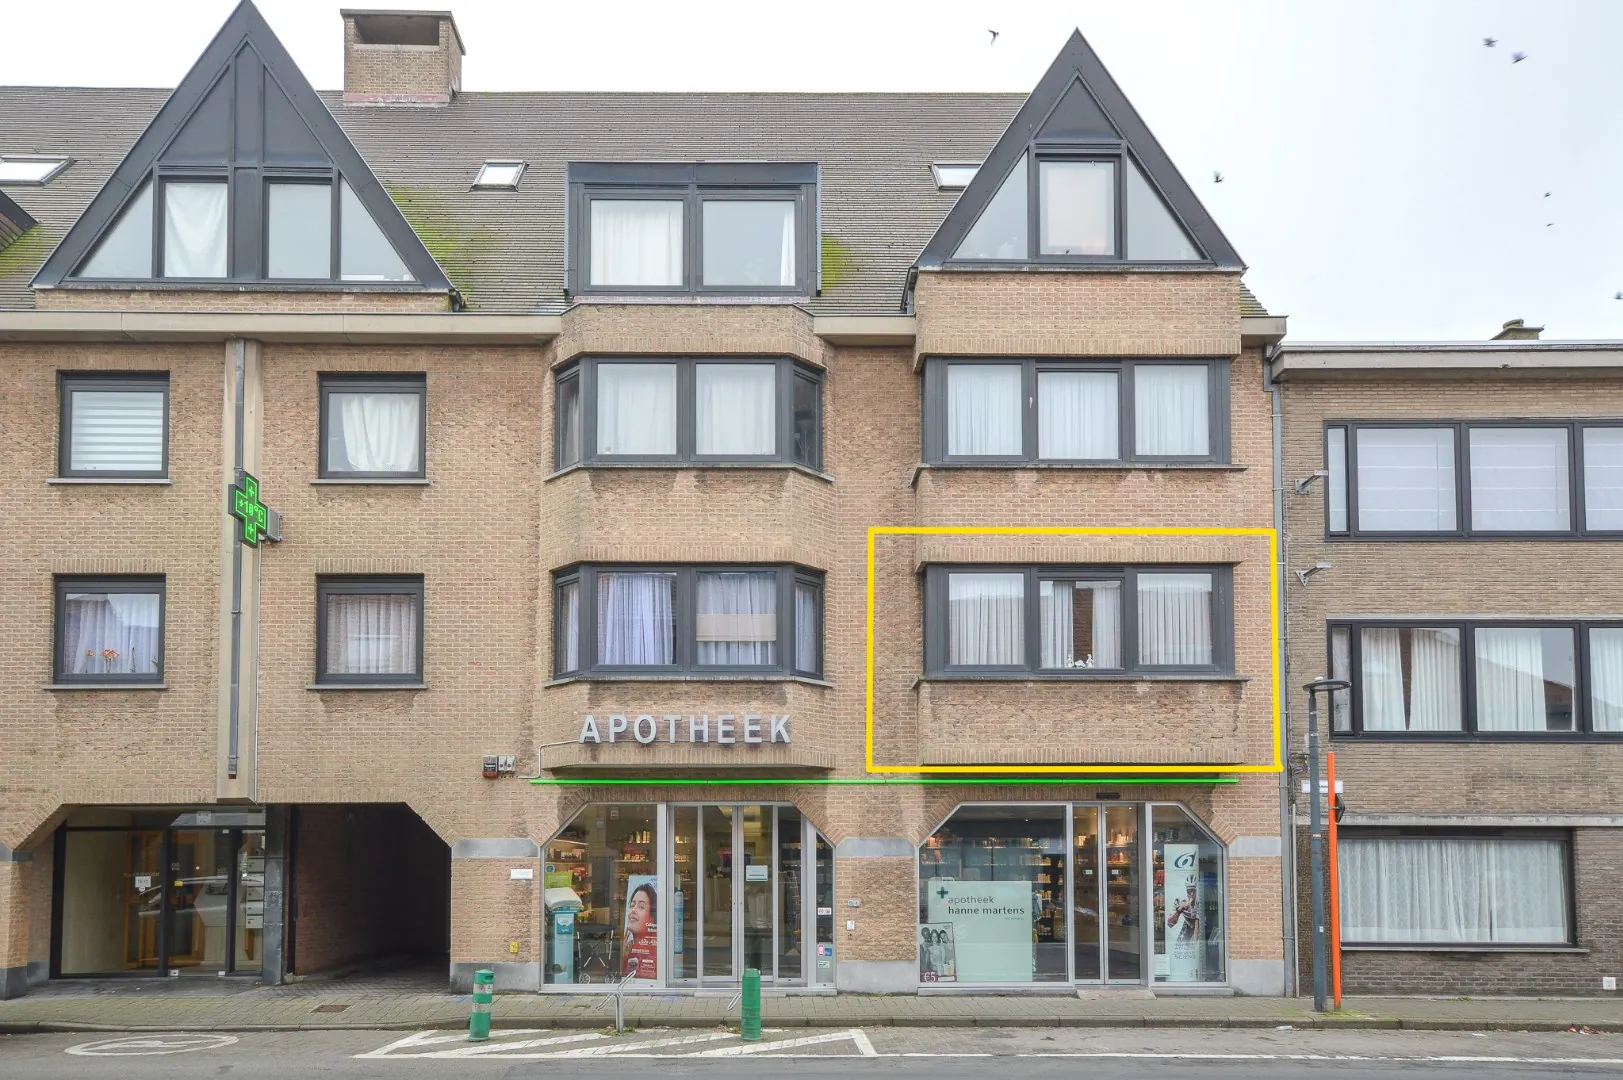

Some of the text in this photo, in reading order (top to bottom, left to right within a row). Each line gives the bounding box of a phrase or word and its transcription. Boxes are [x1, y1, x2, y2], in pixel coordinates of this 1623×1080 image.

[579, 714, 791, 744] APOTHEEK
[948, 896, 995, 905] apotheek
[948, 906, 1025, 914] hanne martens
[923, 971, 936, 982] €5
